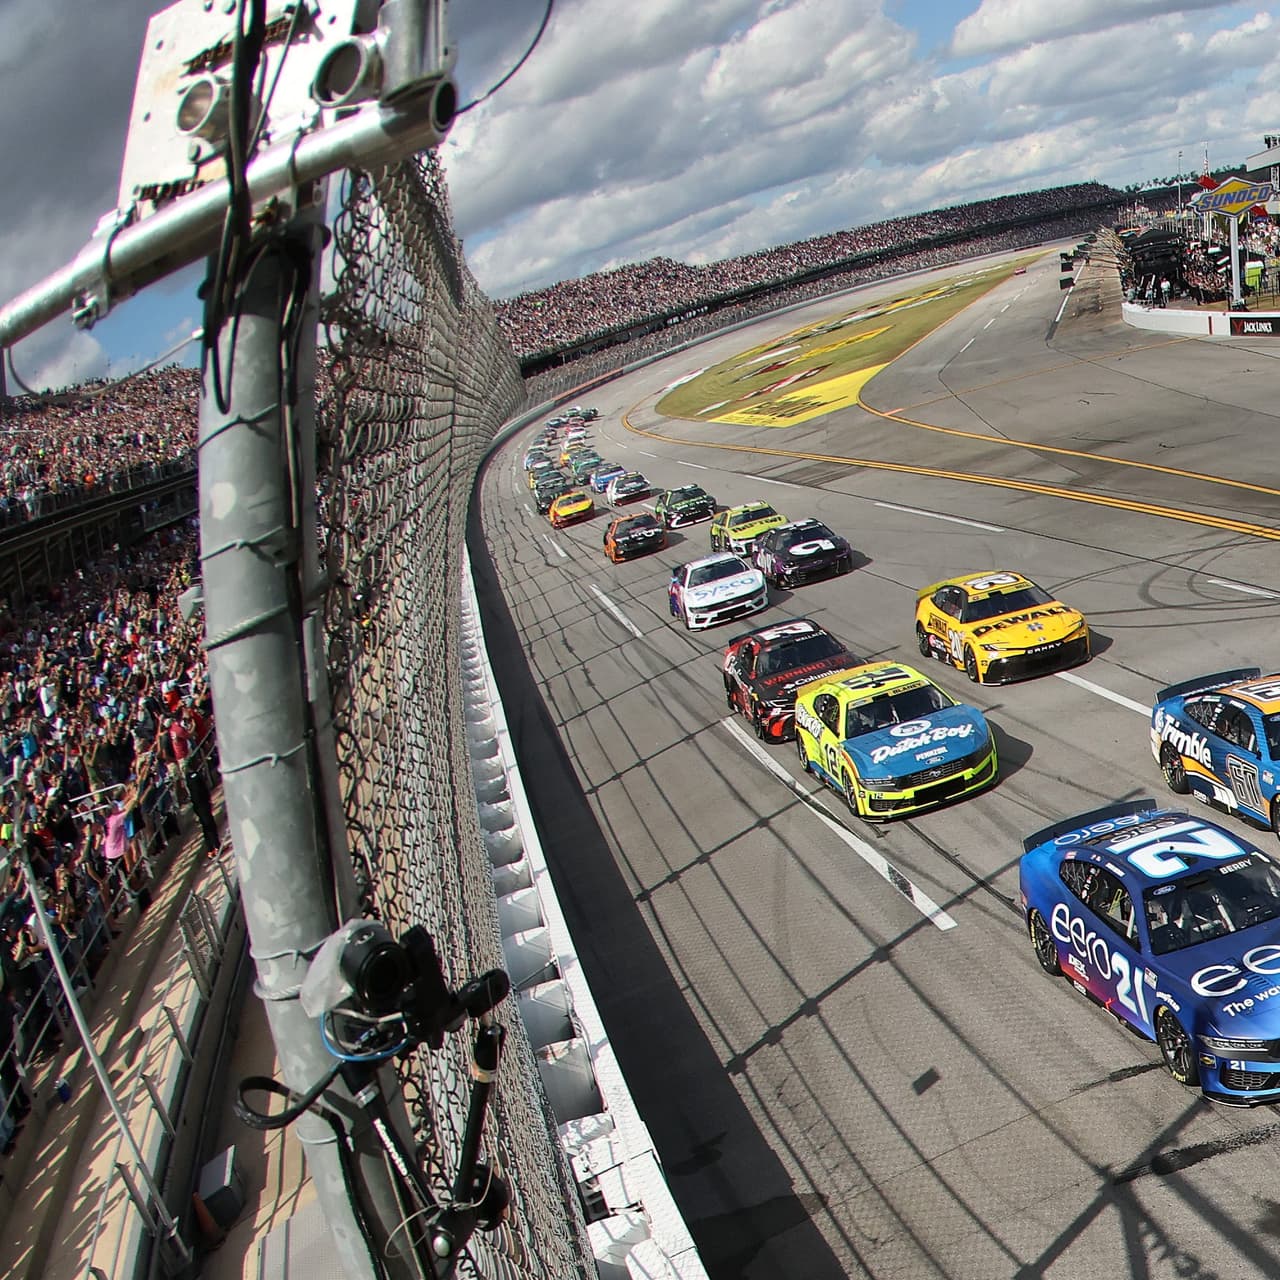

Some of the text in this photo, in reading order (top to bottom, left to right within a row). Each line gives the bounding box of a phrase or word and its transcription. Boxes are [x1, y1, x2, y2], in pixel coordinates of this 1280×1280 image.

[1199, 185, 1271, 210] SUNOCO
[971, 606, 1075, 638] DEWALT
[1026, 642, 1062, 656] CAMRY
[892, 681, 925, 695] BLANEY
[824, 742, 841, 779] 12
[870, 731, 932, 765] Dutch
[914, 745, 950, 762] PENNZOIL
[1054, 814, 1140, 846] eero
[1105, 819, 1247, 880] 21
[1218, 858, 1255, 877] BERRY
[1051, 902, 1112, 981] eero
[1111, 950, 1151, 1026] 21
[1223, 993, 1255, 1018] The
[1229, 1058, 1246, 1071] 21
